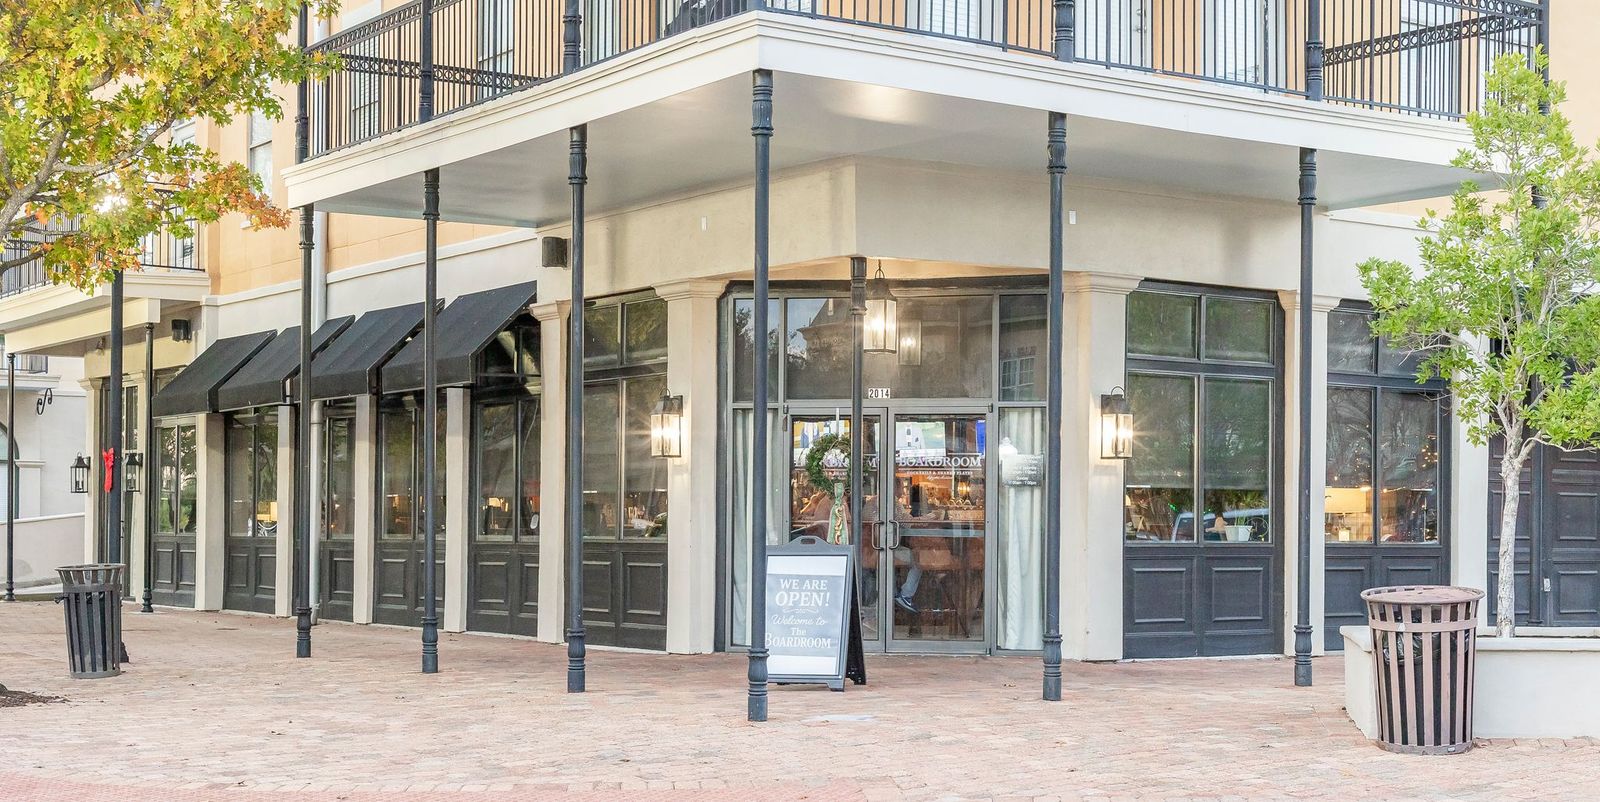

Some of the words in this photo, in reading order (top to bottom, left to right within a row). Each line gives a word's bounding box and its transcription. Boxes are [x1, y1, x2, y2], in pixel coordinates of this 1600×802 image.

[869, 388, 890, 398] 2014
[899, 456, 982, 467] BOARDROOM
[780, 579, 799, 590] WE
[802, 580, 828, 590] ARE
[775, 591, 830, 607] OPEN!
[771, 615, 814, 625] Welcome
[815, 616, 828, 626] to
[791, 627, 807, 635] The
[765, 633, 831, 648] BOARDROOM
